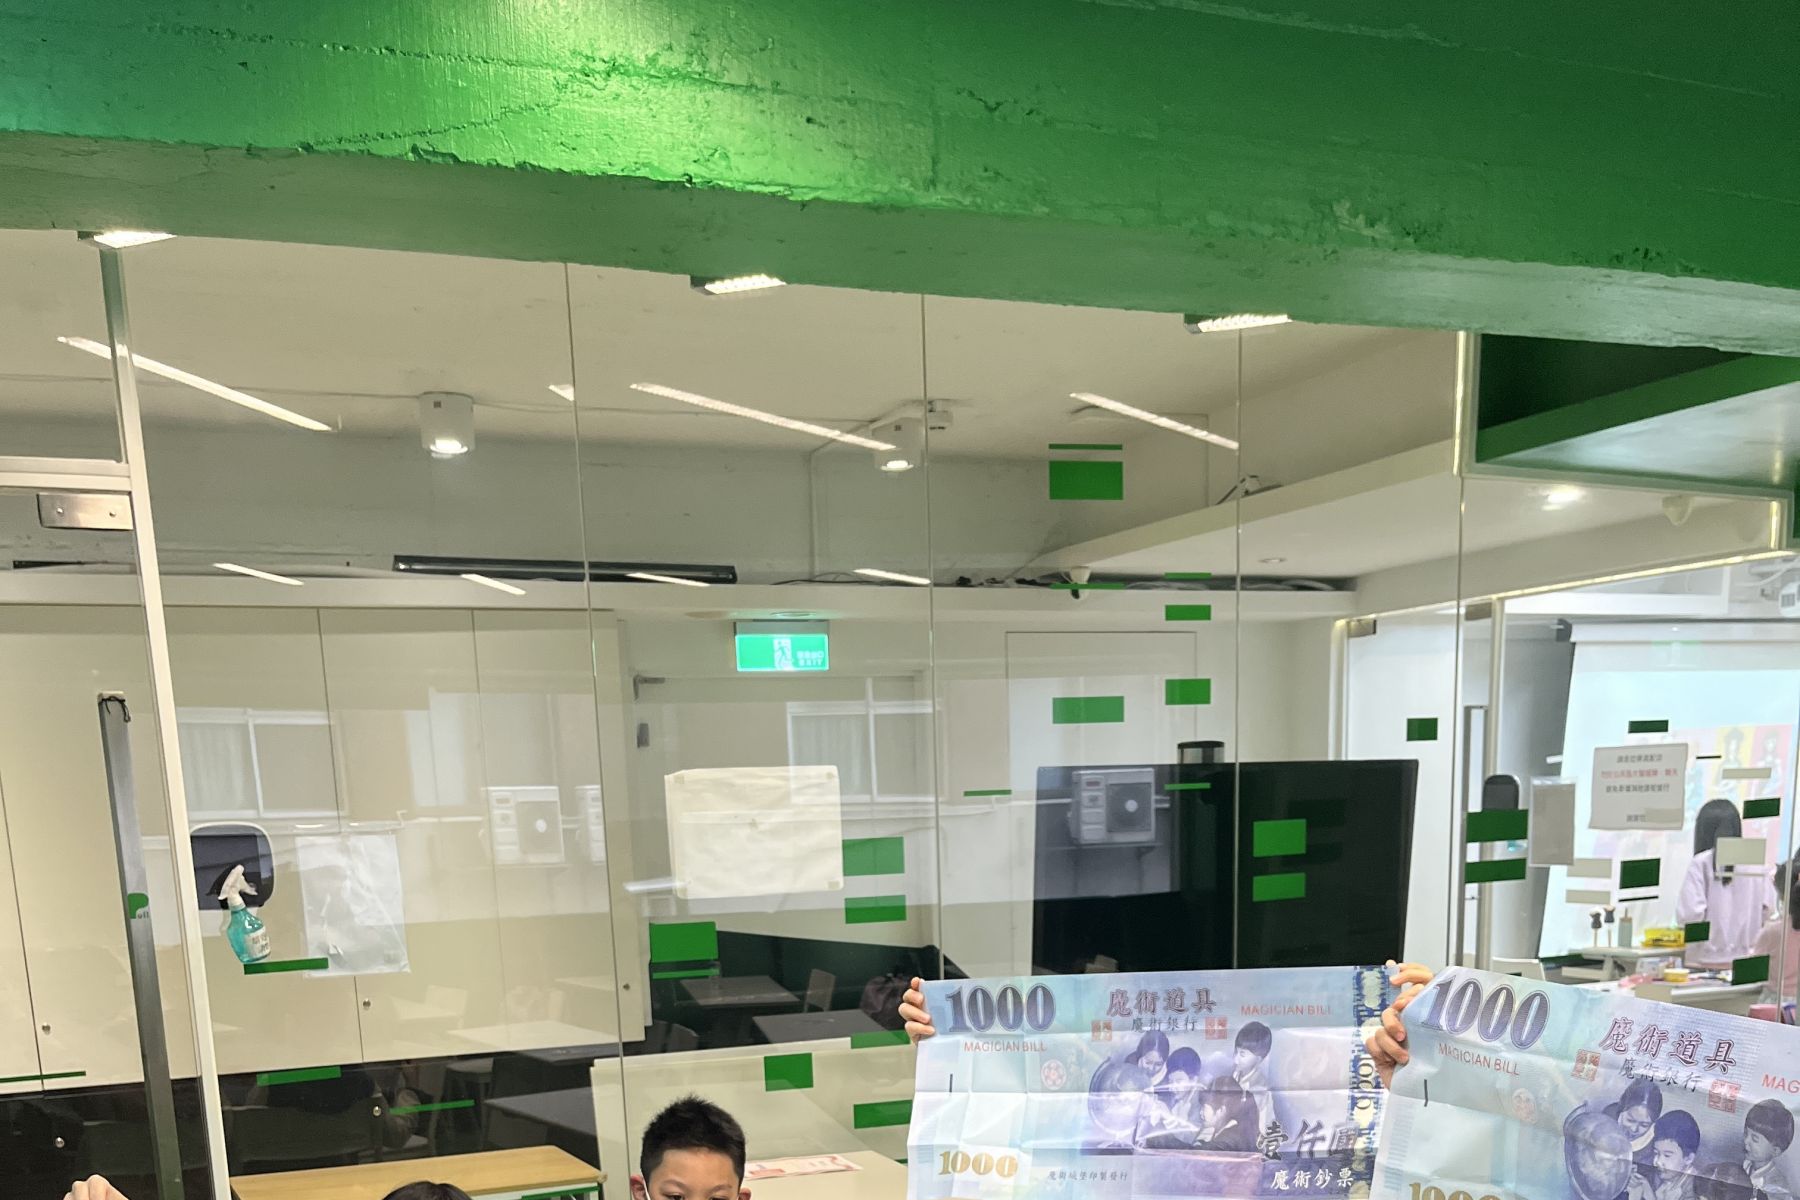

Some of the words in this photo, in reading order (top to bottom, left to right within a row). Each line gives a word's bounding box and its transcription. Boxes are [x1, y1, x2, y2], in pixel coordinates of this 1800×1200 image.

[945, 983, 1056, 1032] 1000
[1106, 987, 1217, 1017] 魔術道具
[1241, 1005, 1304, 1015] MAGICIAN
[1420, 975, 1550, 1049] 1000
[964, 1041, 1020, 1052] MAGICIAN
[1023, 1041, 1048, 1052] BILL
[1439, 1043, 1491, 1069] MAGICIAN
[1494, 1059, 1520, 1076] BILL
[1599, 1016, 1737, 1075] 魔術道具
[938, 1150, 1019, 1178] 1000
[1270, 1167, 1354, 1190] 魔術鈔票
